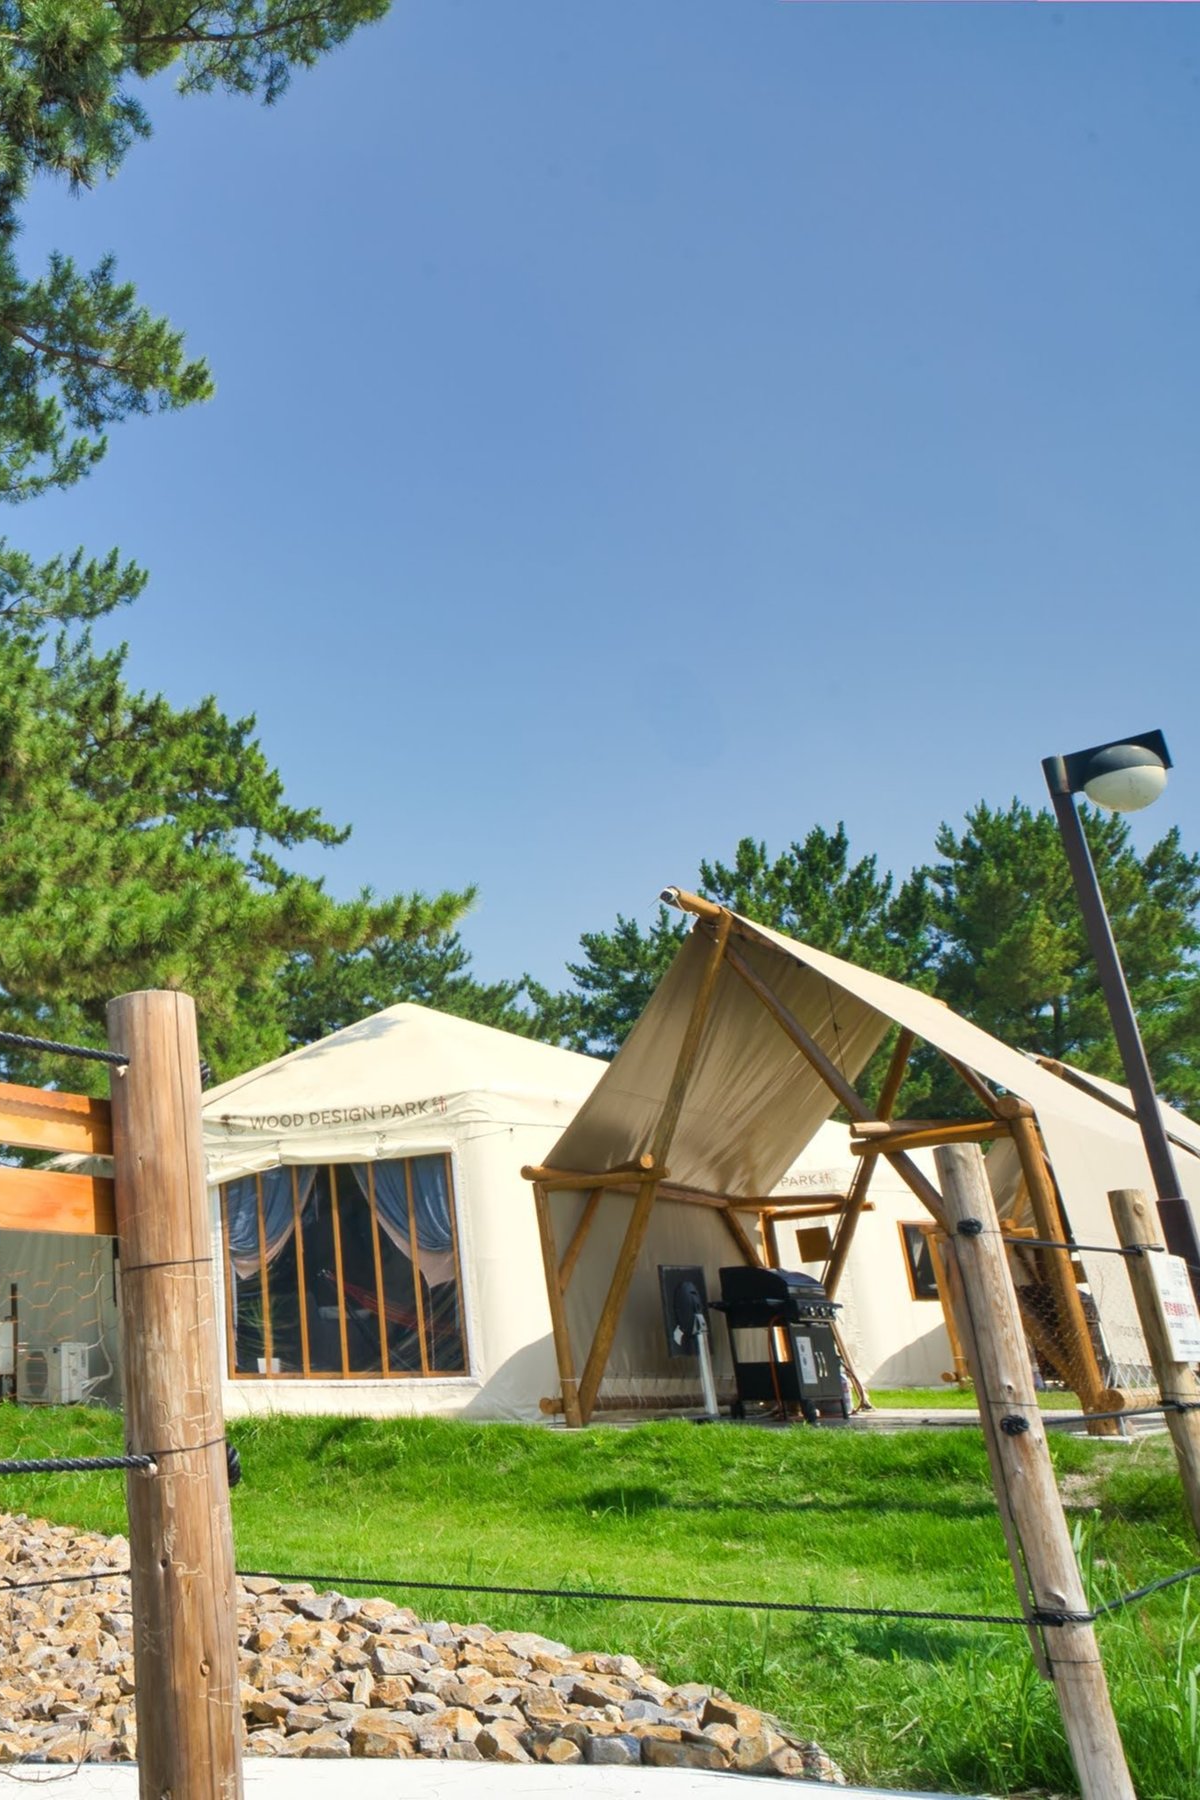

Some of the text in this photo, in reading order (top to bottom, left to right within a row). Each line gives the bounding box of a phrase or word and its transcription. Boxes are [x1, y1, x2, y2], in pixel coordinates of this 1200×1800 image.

[250, 1113, 304, 1130] WOOD
[309, 1106, 376, 1126] DESIGN
[381, 1099, 429, 1119] PARK
